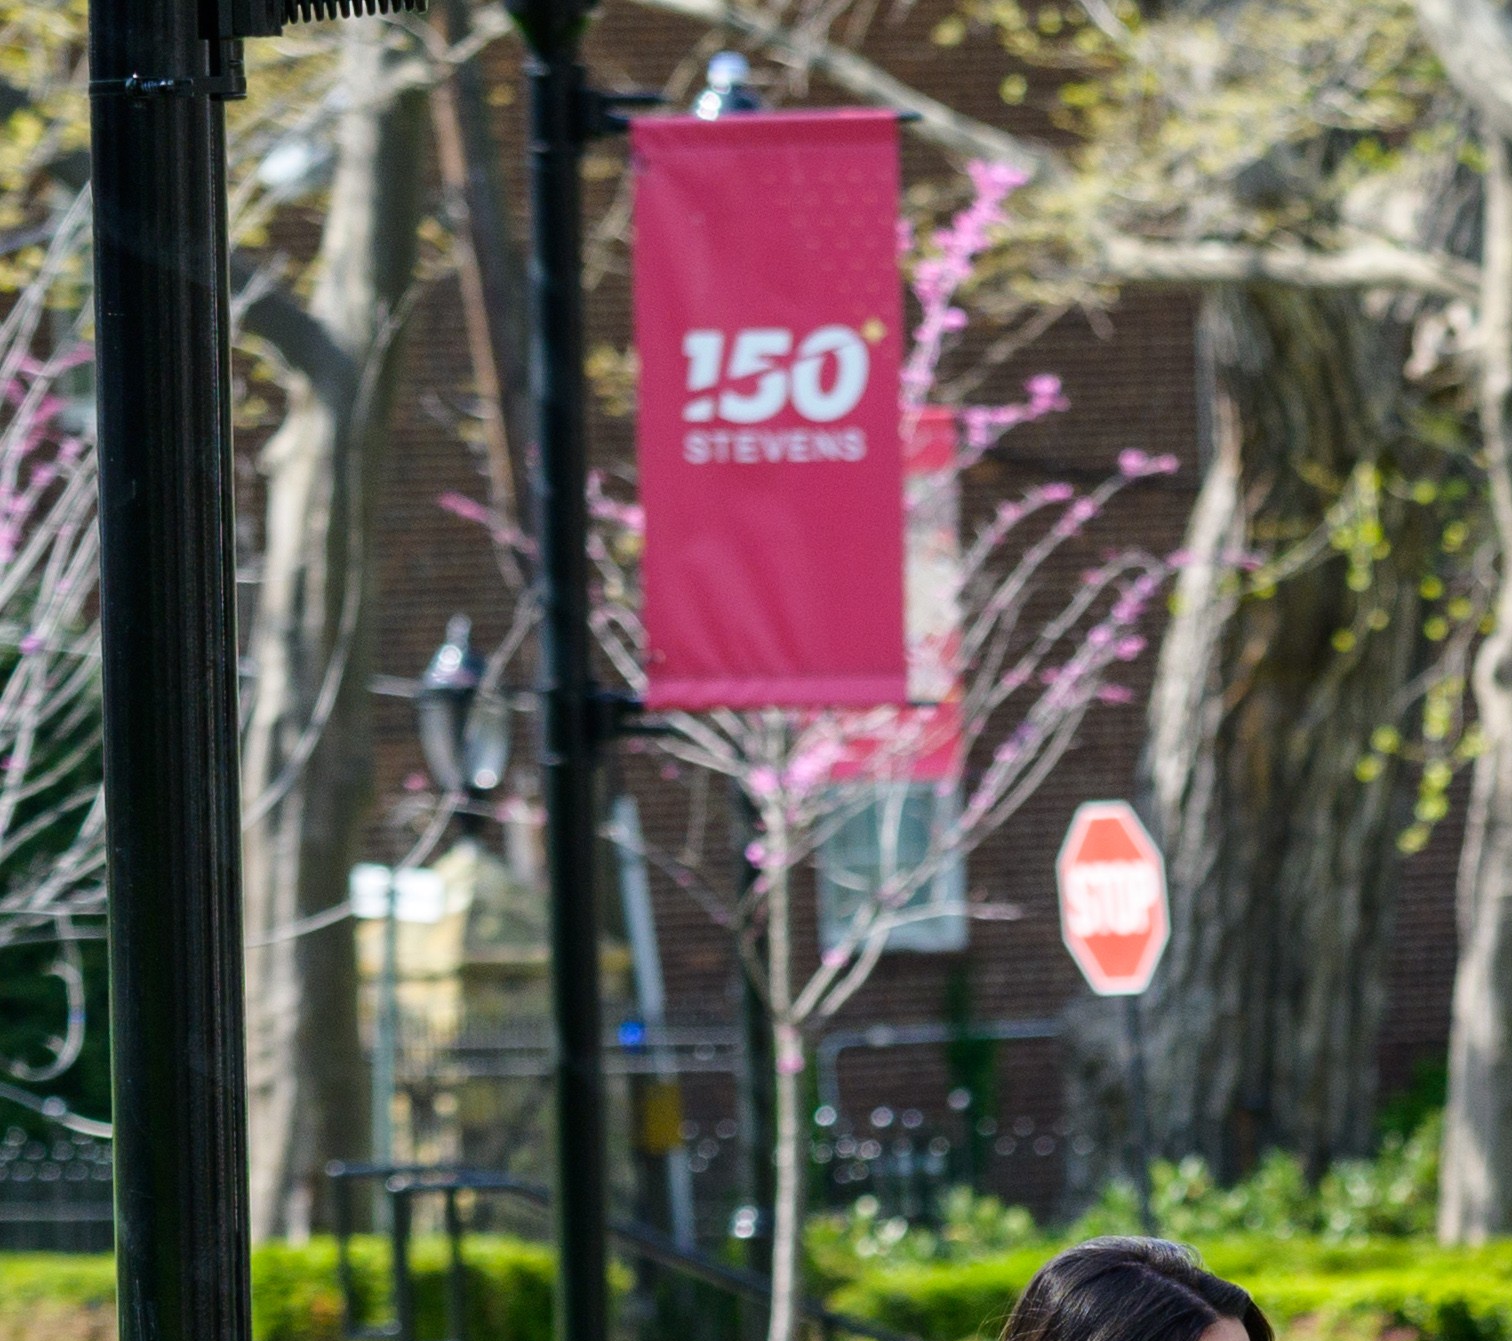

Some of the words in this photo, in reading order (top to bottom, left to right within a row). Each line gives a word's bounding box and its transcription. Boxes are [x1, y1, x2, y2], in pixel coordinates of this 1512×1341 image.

[682, 323, 870, 424] 150
[682, 427, 866, 465] STEVENS
[1066, 861, 1159, 936] STOP
